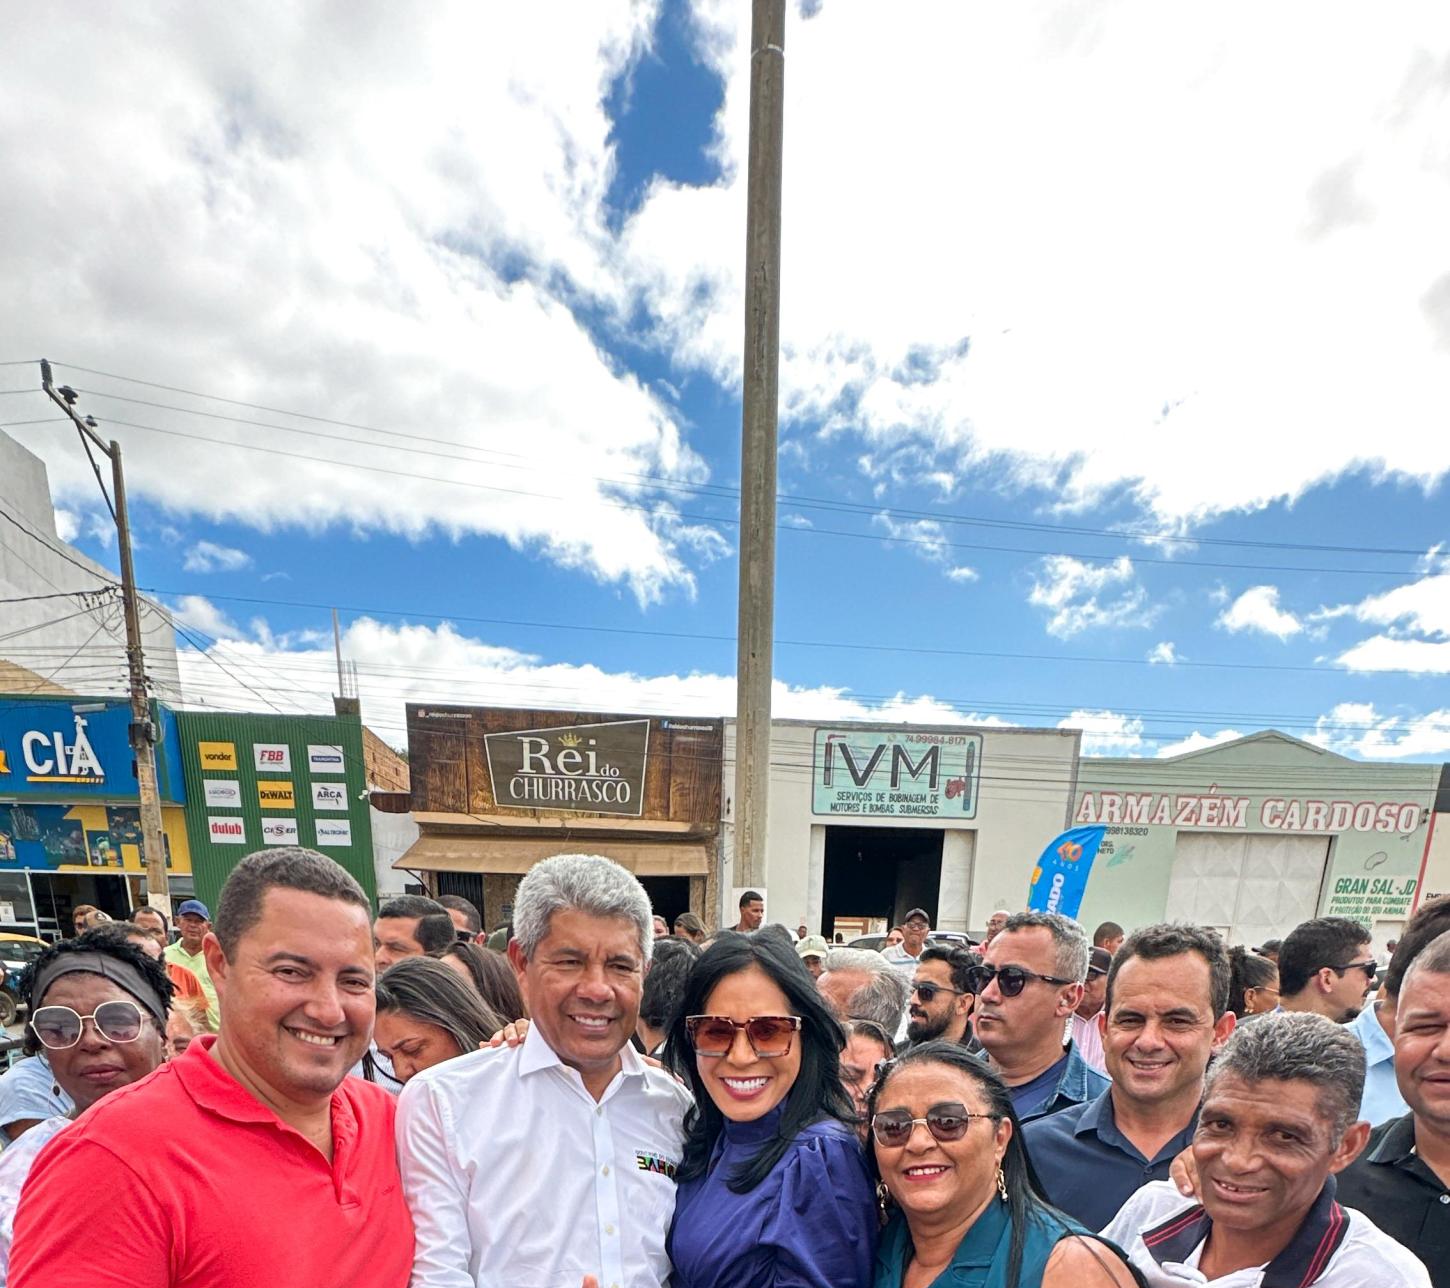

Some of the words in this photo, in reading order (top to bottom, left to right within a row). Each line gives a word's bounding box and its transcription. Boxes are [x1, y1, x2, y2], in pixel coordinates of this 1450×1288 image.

[204, 752, 231, 761] vonder
[260, 750, 284, 761] FBB
[516, 736, 600, 776] Rei
[600, 764, 620, 777] do
[317, 790, 342, 798] ARCA
[509, 777, 631, 803] CHURRASCO
[836, 791, 872, 803] SERVIÇOS
[876, 792, 885, 802] DE
[930, 794, 939, 804] DE
[830, 802, 860, 812] MOTORES
[862, 803, 867, 812] E
[869, 804, 894, 813] BOMBAS
[899, 804, 939, 815] SUBMERSAS
[1076, 784, 1250, 828] ARMAZÉM
[1260, 798, 1421, 833] CARDOSO
[211, 822, 242, 835] dulub
[1334, 878, 1370, 894] GRAN
[1370, 879, 1394, 895] SAL
[1331, 896, 1365, 904] PRODUTOS
[1365, 896, 1382, 904] PARA
[1383, 897, 1412, 905] COMBATE
[1383, 906, 1406, 915] ANIMAL
